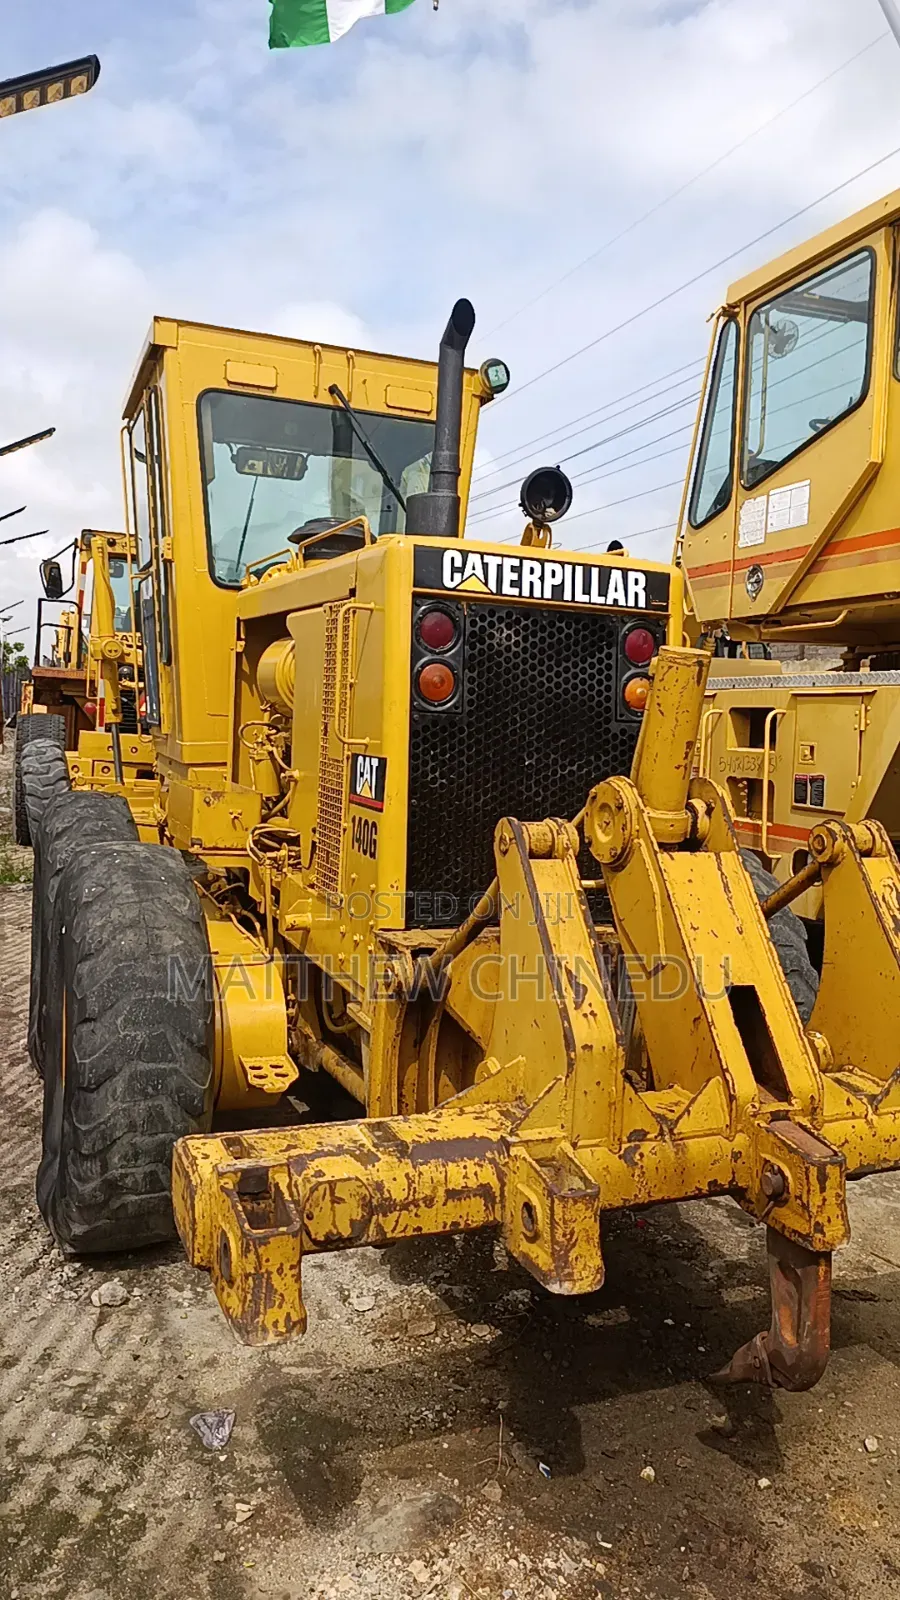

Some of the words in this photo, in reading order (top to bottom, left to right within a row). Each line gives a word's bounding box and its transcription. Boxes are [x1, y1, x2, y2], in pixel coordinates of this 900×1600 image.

[442, 549, 647, 608] CATERPILLAR
[355, 754, 379, 800] CAT
[351, 814, 378, 860] 140G
